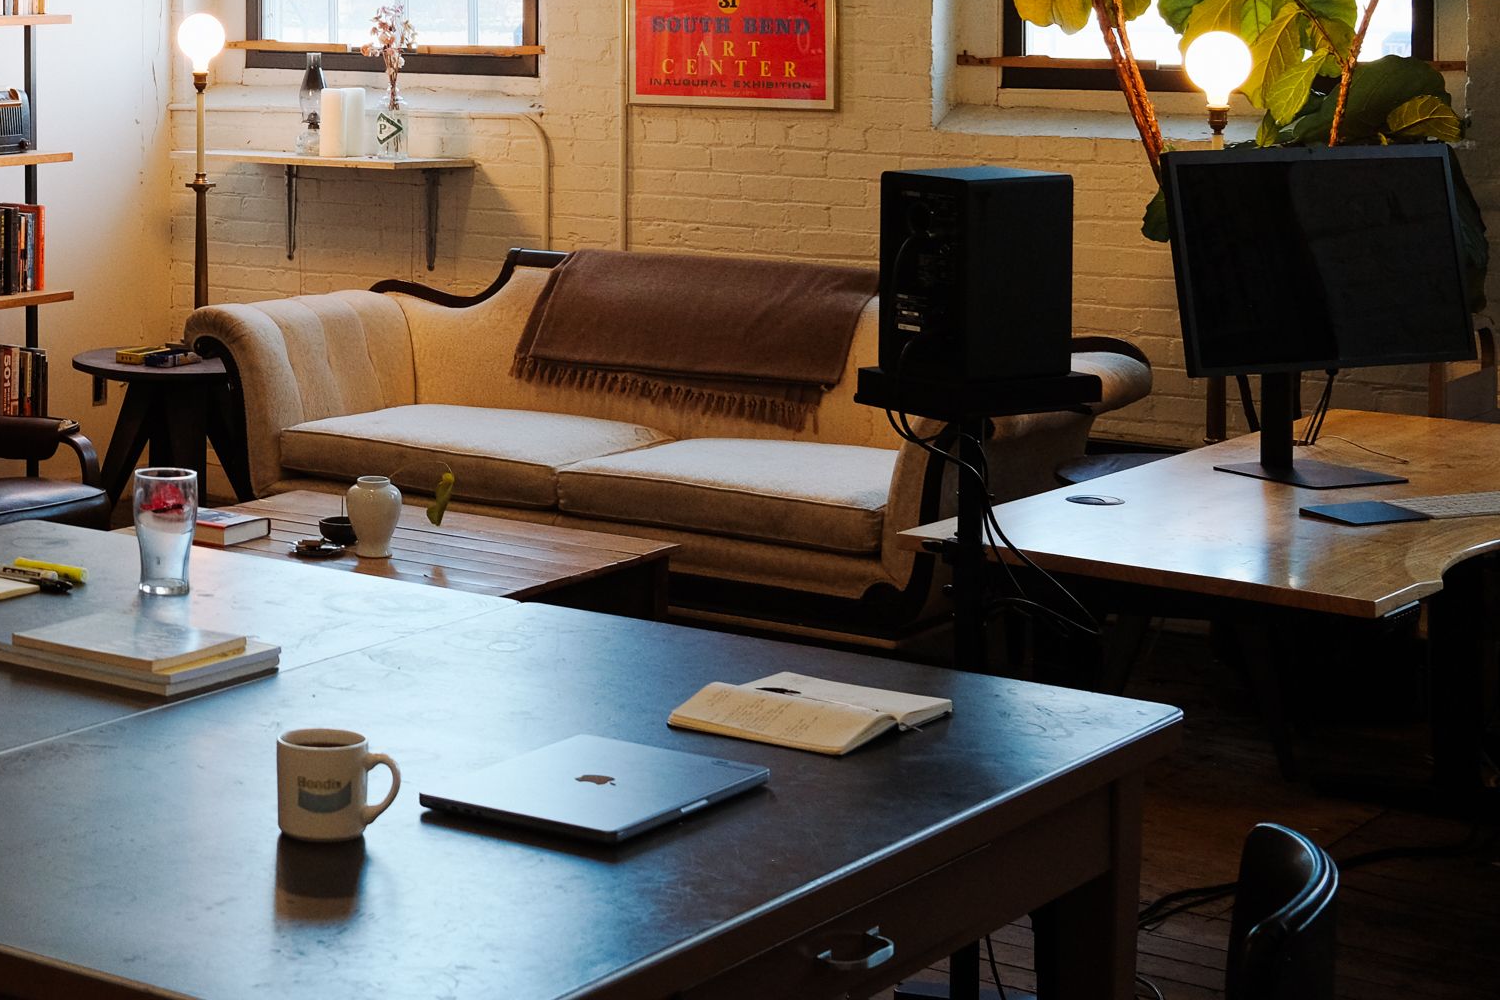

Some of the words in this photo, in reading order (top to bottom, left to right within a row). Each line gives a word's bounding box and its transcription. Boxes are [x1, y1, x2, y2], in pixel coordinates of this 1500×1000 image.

[652, 16, 732, 34] SOUTH
[742, 17, 810, 36] BEND
[696, 40, 761, 58] ART
[661, 58, 797, 78] CENTER
[649, 78, 726, 88] INAUGURAL
[733, 80, 812, 90] EXHIBITION
[3, 354, 11, 387] 501
